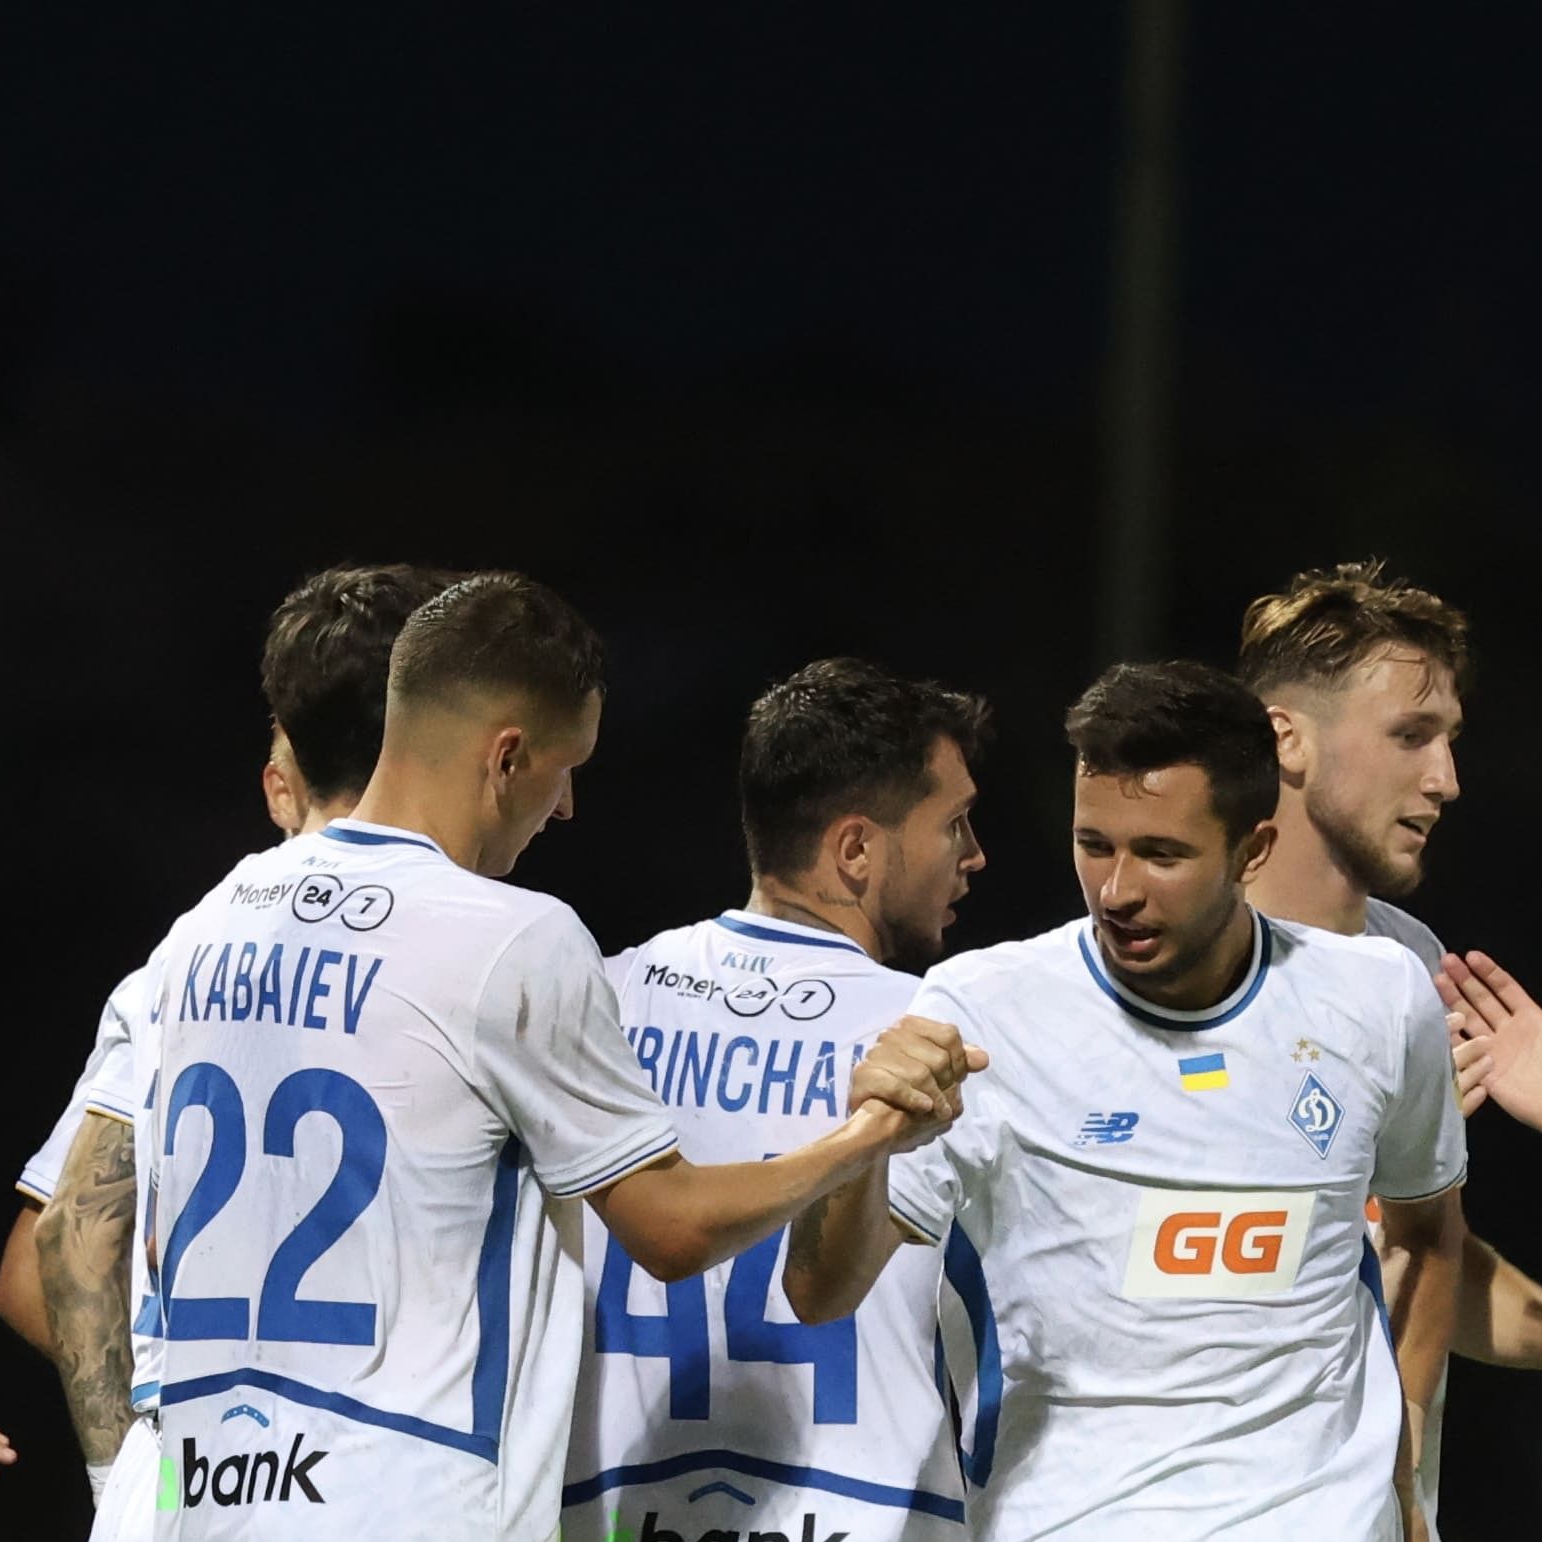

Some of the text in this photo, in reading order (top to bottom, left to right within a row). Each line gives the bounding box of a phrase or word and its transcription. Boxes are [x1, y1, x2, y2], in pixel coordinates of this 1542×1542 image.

[230, 882, 378, 914] Money 24 7
[178, 942, 382, 1034] KABAIEV
[644, 964, 723, 1001] Money
[159, 1062, 387, 1346] 22
[1153, 1211, 1288, 1275] GG
[595, 1153, 858, 1425] 44
